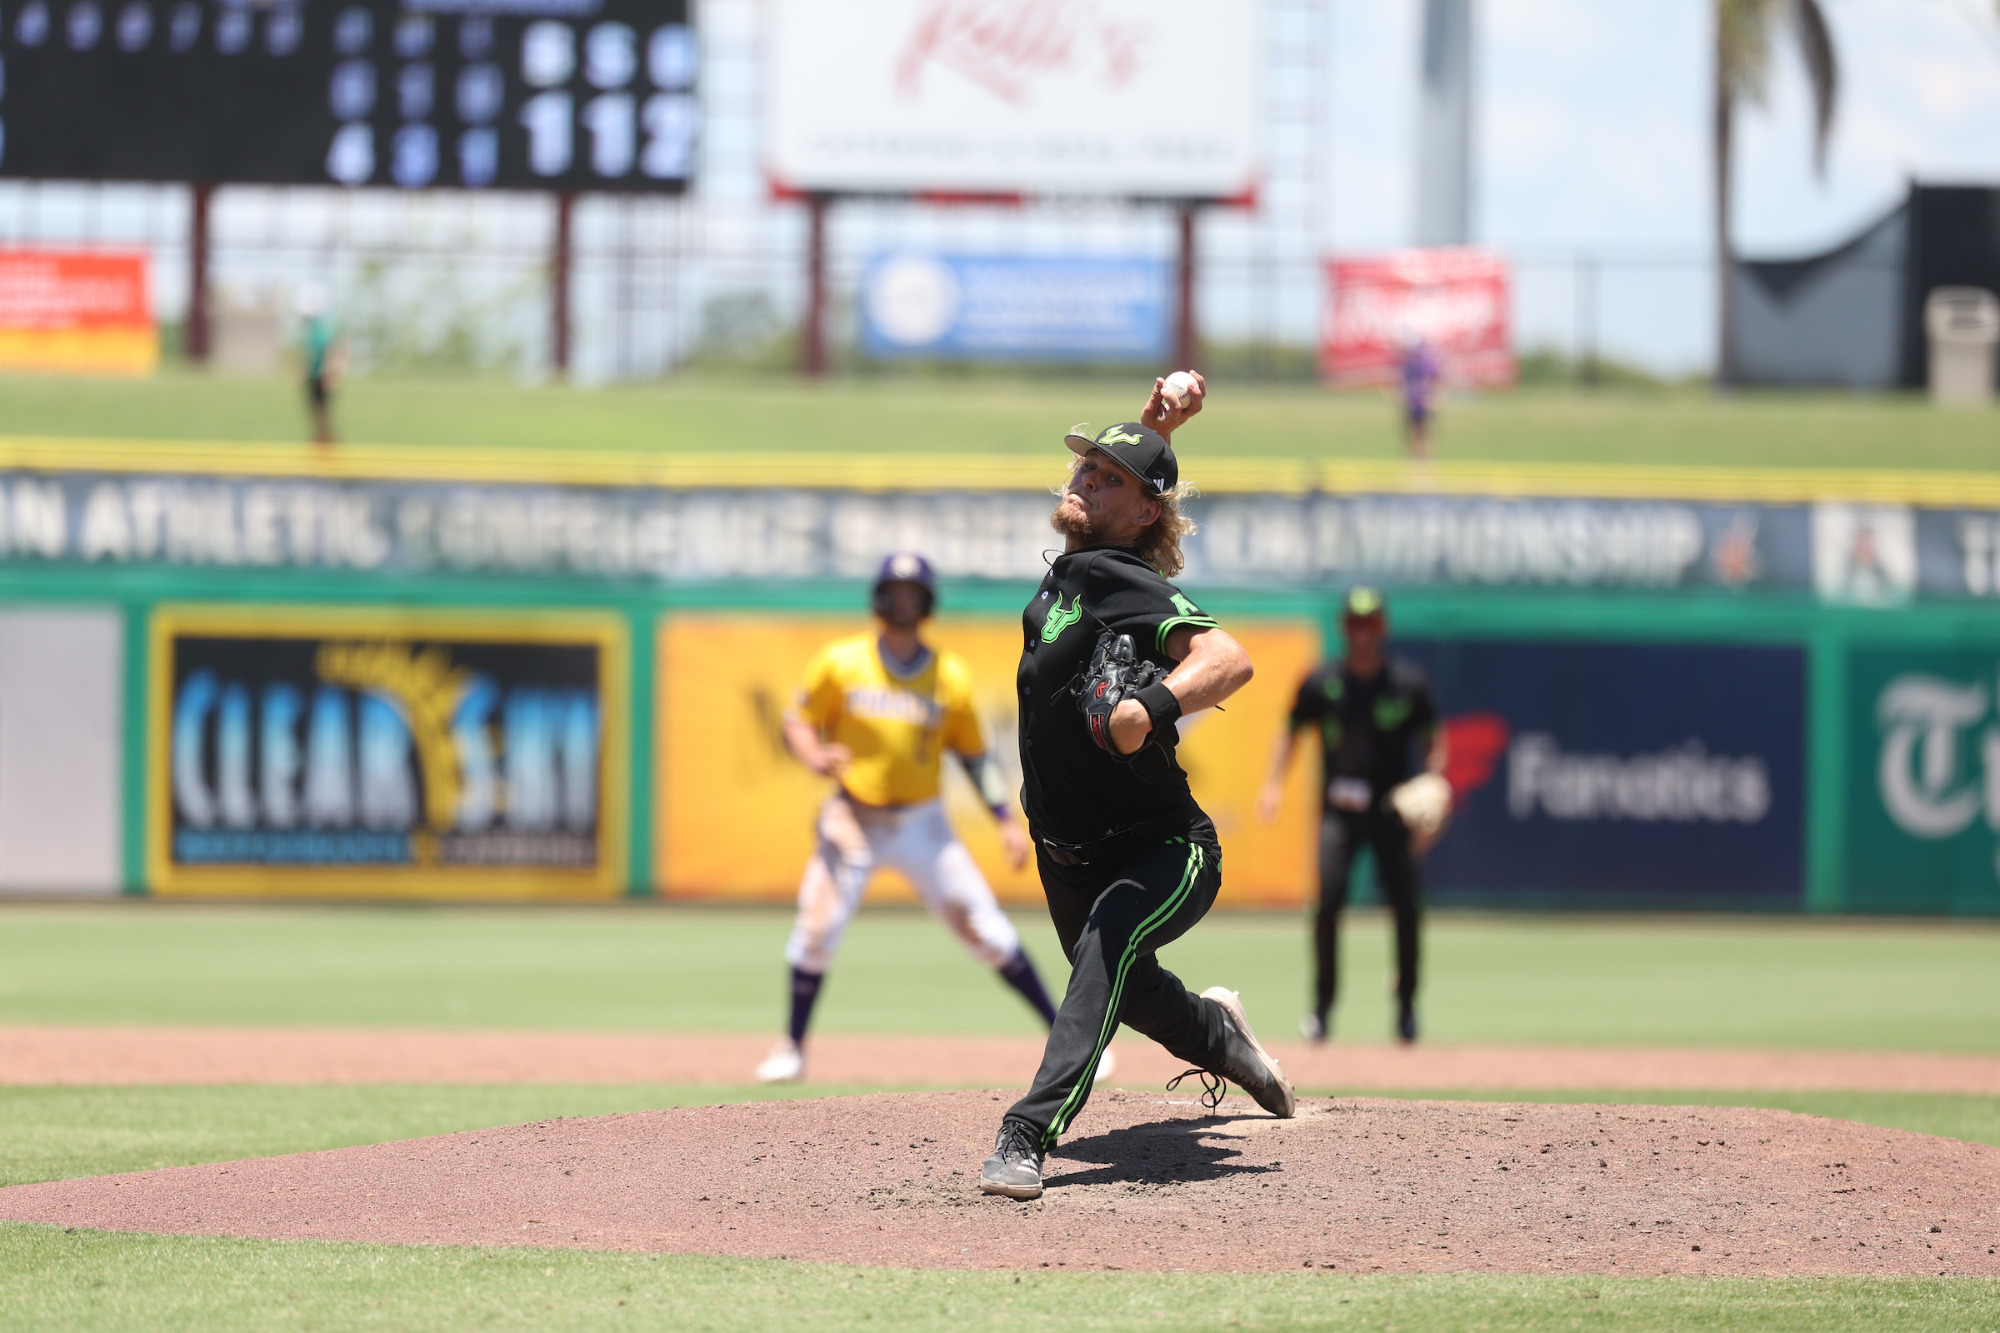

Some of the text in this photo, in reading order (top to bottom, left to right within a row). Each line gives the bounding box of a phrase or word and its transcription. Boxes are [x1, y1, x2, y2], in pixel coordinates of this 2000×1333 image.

[518, 91, 698, 179] 1 1 2
[81, 482, 392, 569] ATHLETIC
[1506, 731, 1770, 823] Fanatics
